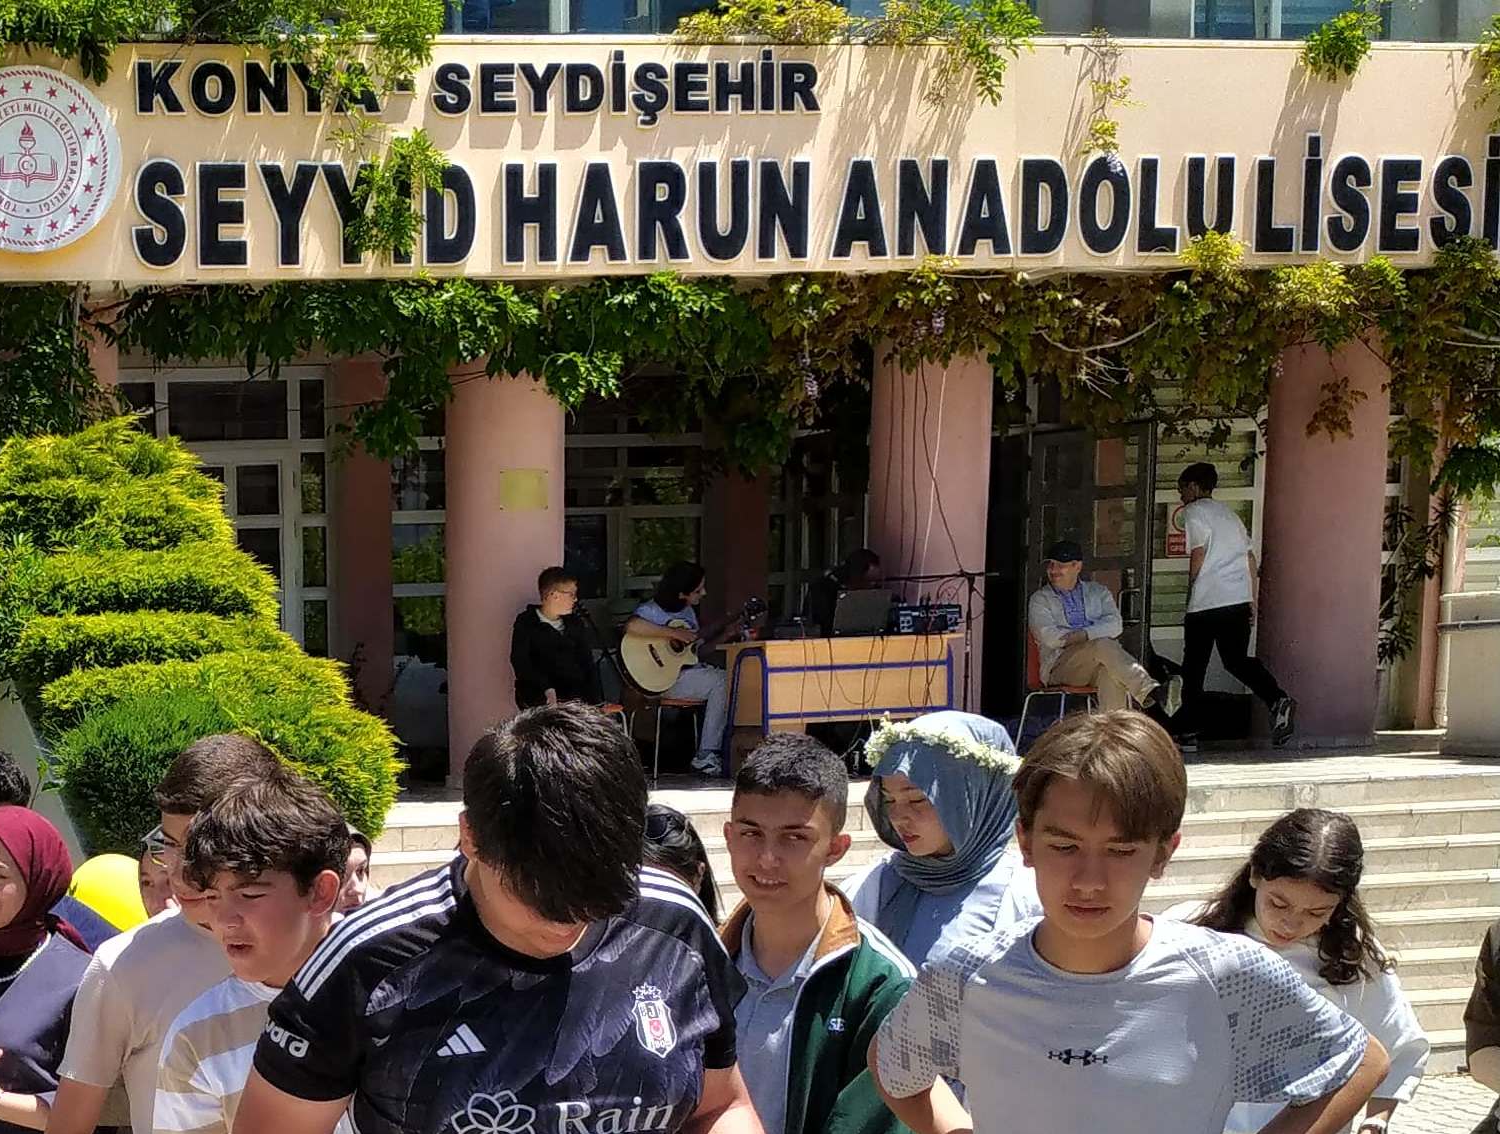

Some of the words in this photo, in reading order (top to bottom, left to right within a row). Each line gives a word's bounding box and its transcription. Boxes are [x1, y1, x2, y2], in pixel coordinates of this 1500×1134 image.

[134, 59, 382, 117] KONYA
[431, 48, 821, 126] SEYDİŞEHİR
[501, 158, 810, 266] HARUN
[830, 153, 1238, 260] ANADOLU
